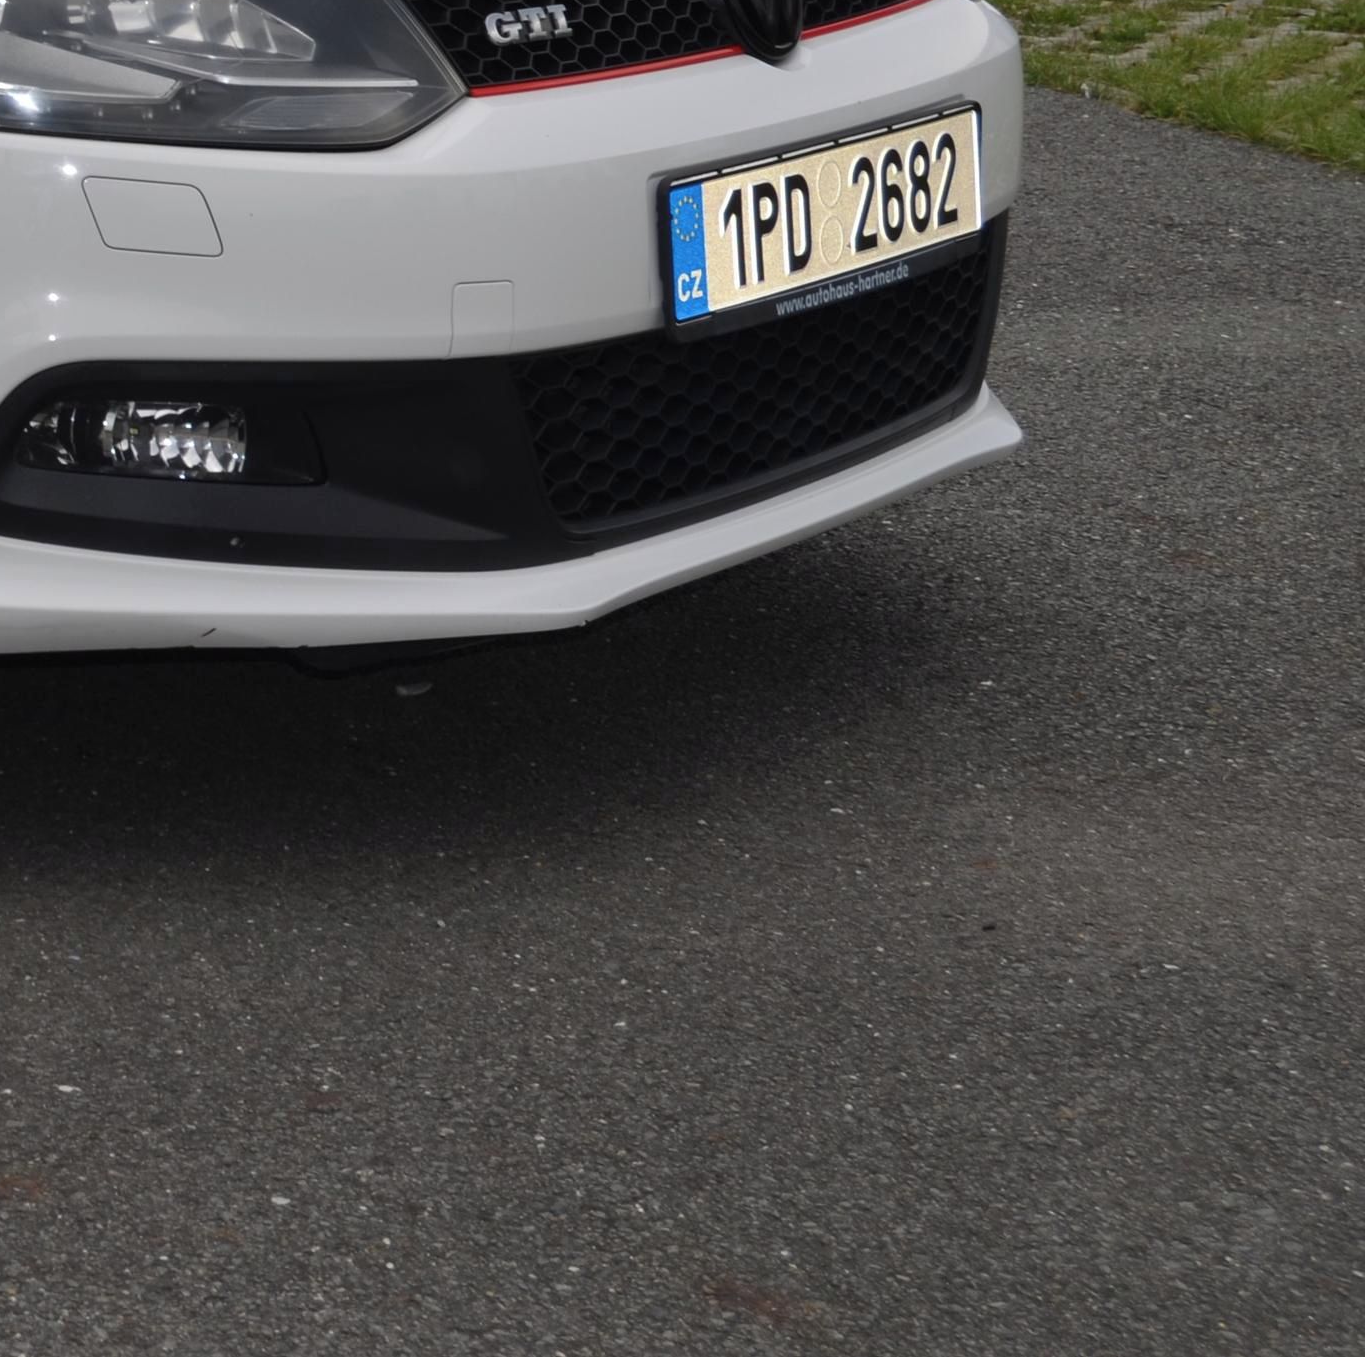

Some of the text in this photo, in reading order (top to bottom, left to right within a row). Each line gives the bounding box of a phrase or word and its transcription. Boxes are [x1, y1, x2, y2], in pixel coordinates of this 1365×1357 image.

[484, 4, 573, 45] GTI
[717, 131, 959, 291] 1PD 2682
[676, 268, 704, 303] CZ
[775, 261, 909, 316] www.autohaus-hartner.de
